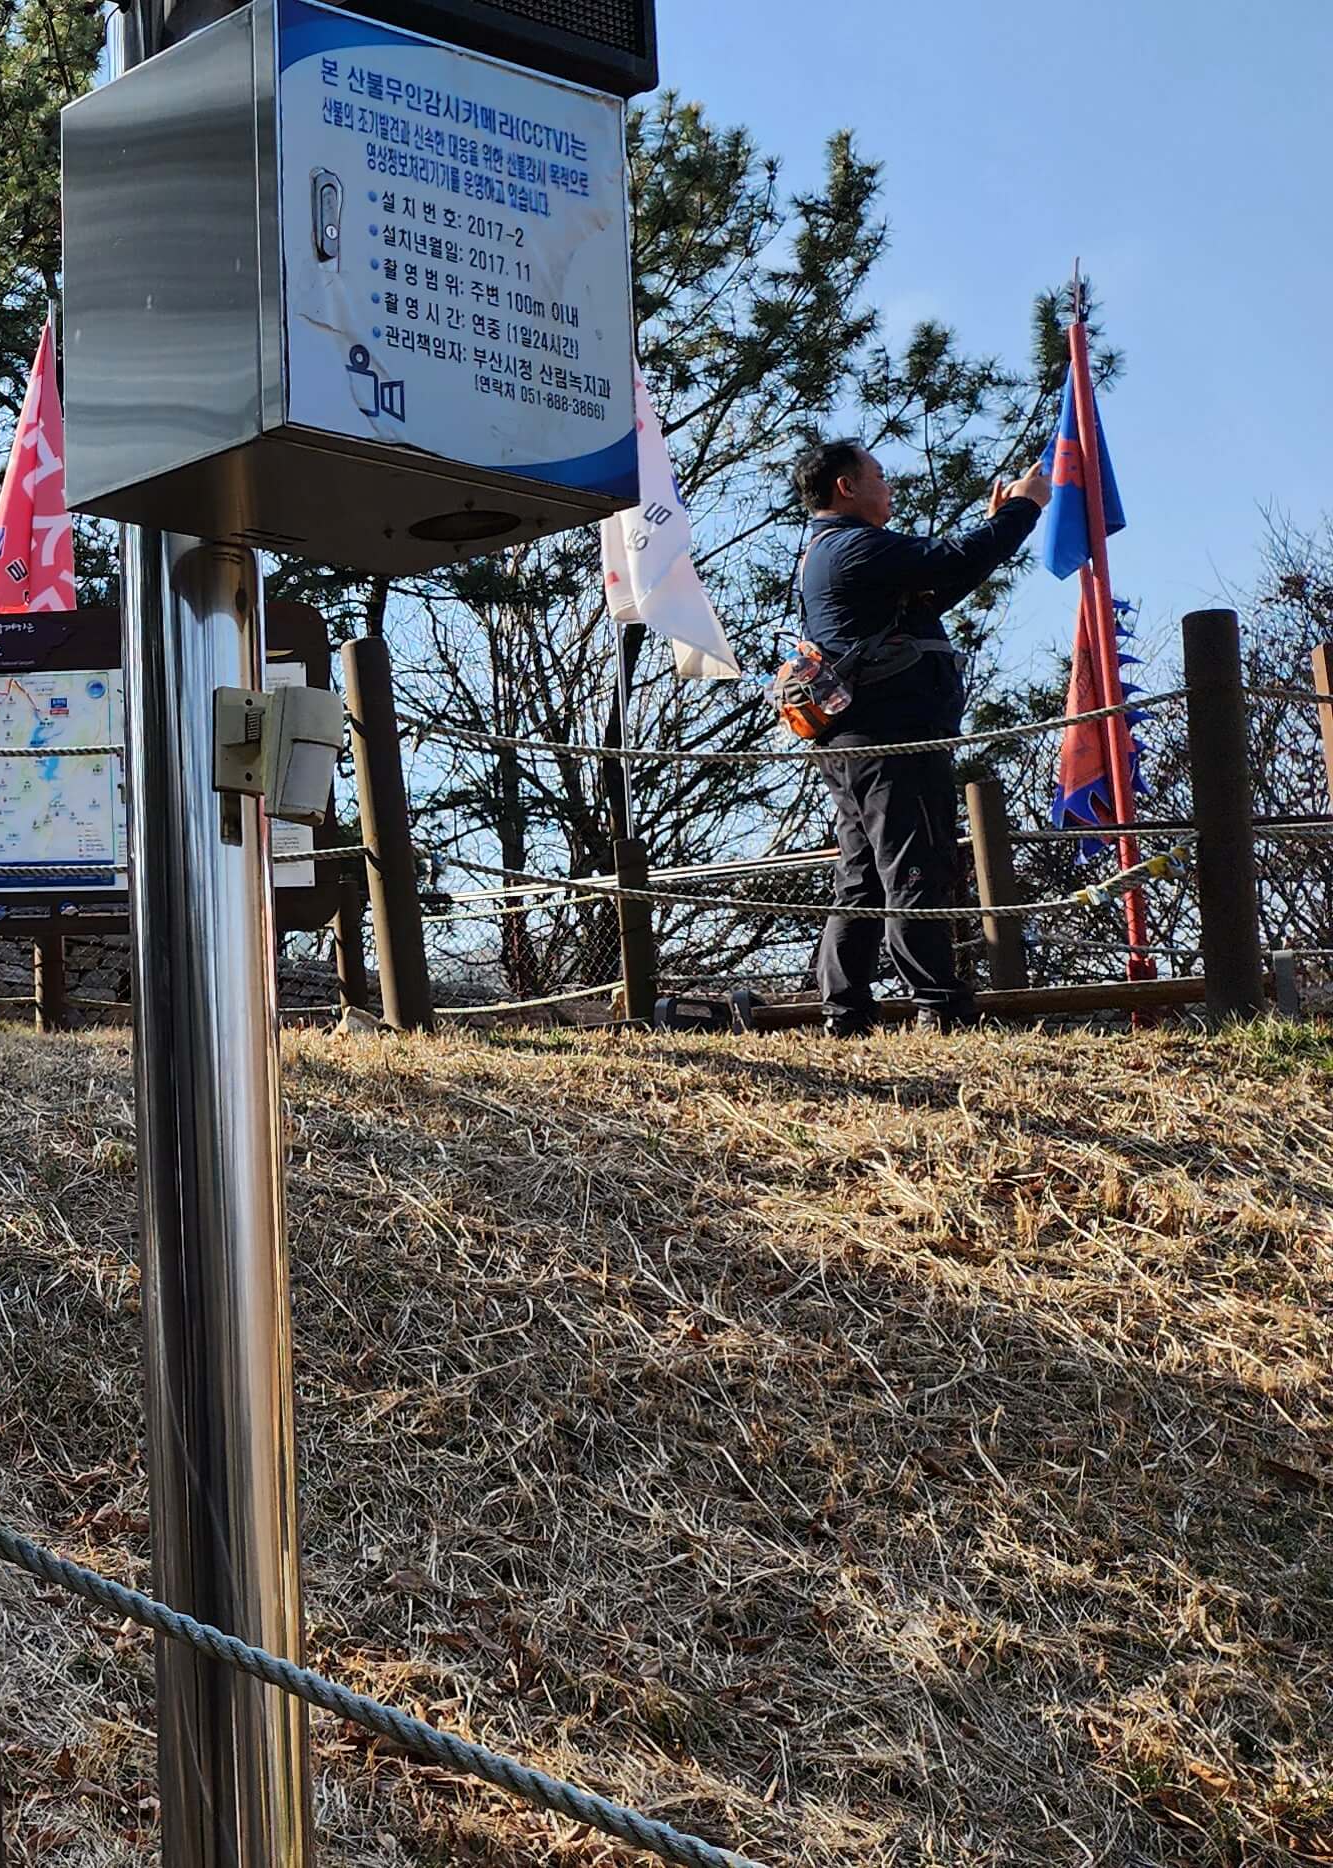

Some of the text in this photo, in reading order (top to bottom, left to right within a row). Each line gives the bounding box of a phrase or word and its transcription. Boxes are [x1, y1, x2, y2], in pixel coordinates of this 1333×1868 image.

[321, 57, 587, 161] 본 산불무인감시카메라(CCTV)는
[323, 97, 353, 130] 산불의
[358, 108, 410, 146] 조기발견과
[414, 123, 444, 157] 신속한
[448, 133, 478, 167] 대응을
[483, 144, 503, 174] 위한
[464, 170, 505, 205] 운영하고
[383, 223, 463, 263] 설치년월일:
[468, 215, 524, 248] 2017-2
[471, 281, 499, 307] 주변
[507, 291, 545, 318] 100m
[552, 303, 579, 328] 이내
[472, 314, 500, 340] 연중
[385, 325, 611, 400] 관리책임자: 부산시청 산림녹지과
